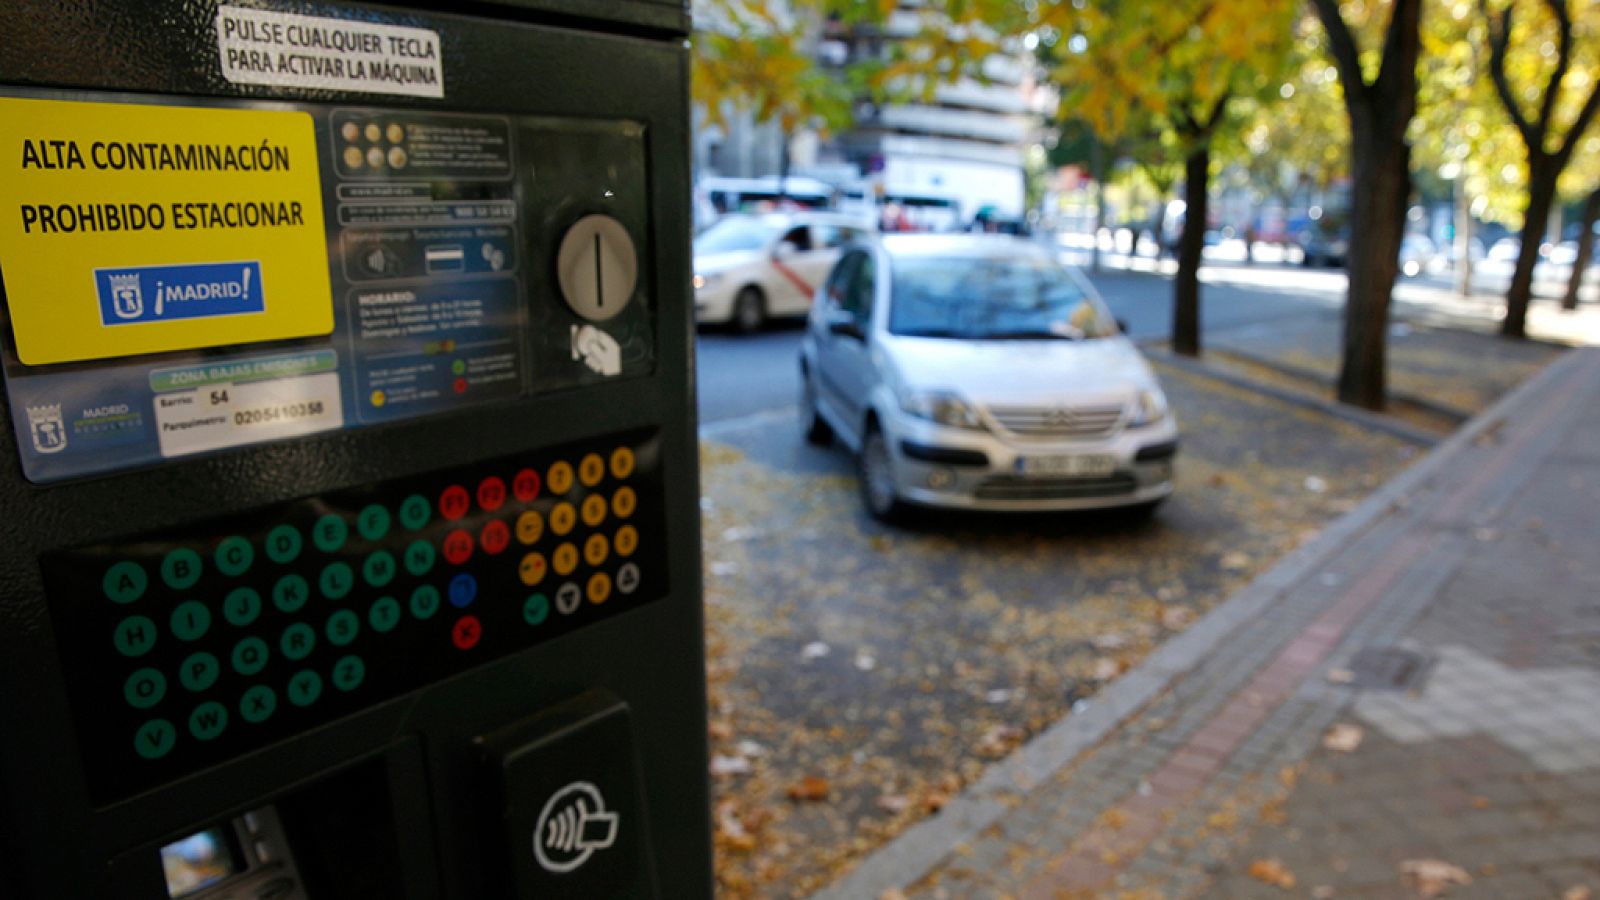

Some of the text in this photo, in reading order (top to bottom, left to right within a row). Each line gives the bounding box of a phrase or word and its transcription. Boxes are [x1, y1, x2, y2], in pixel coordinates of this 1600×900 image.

[224, 17, 436, 60] PULSE CUALQUIER TECLA
[227, 48, 438, 86] PARA ACTIVAR LA MÁQUINA
[22, 139, 290, 172] ALTA CONTAMINACIÓN
[20, 201, 305, 234] PROHIBIDO ESTACIONAR
[170, 369, 207, 385] ZONA
[209, 364, 252, 380] BAJAS
[83, 404, 129, 419] MADRID
[209, 390, 230, 406] 54
